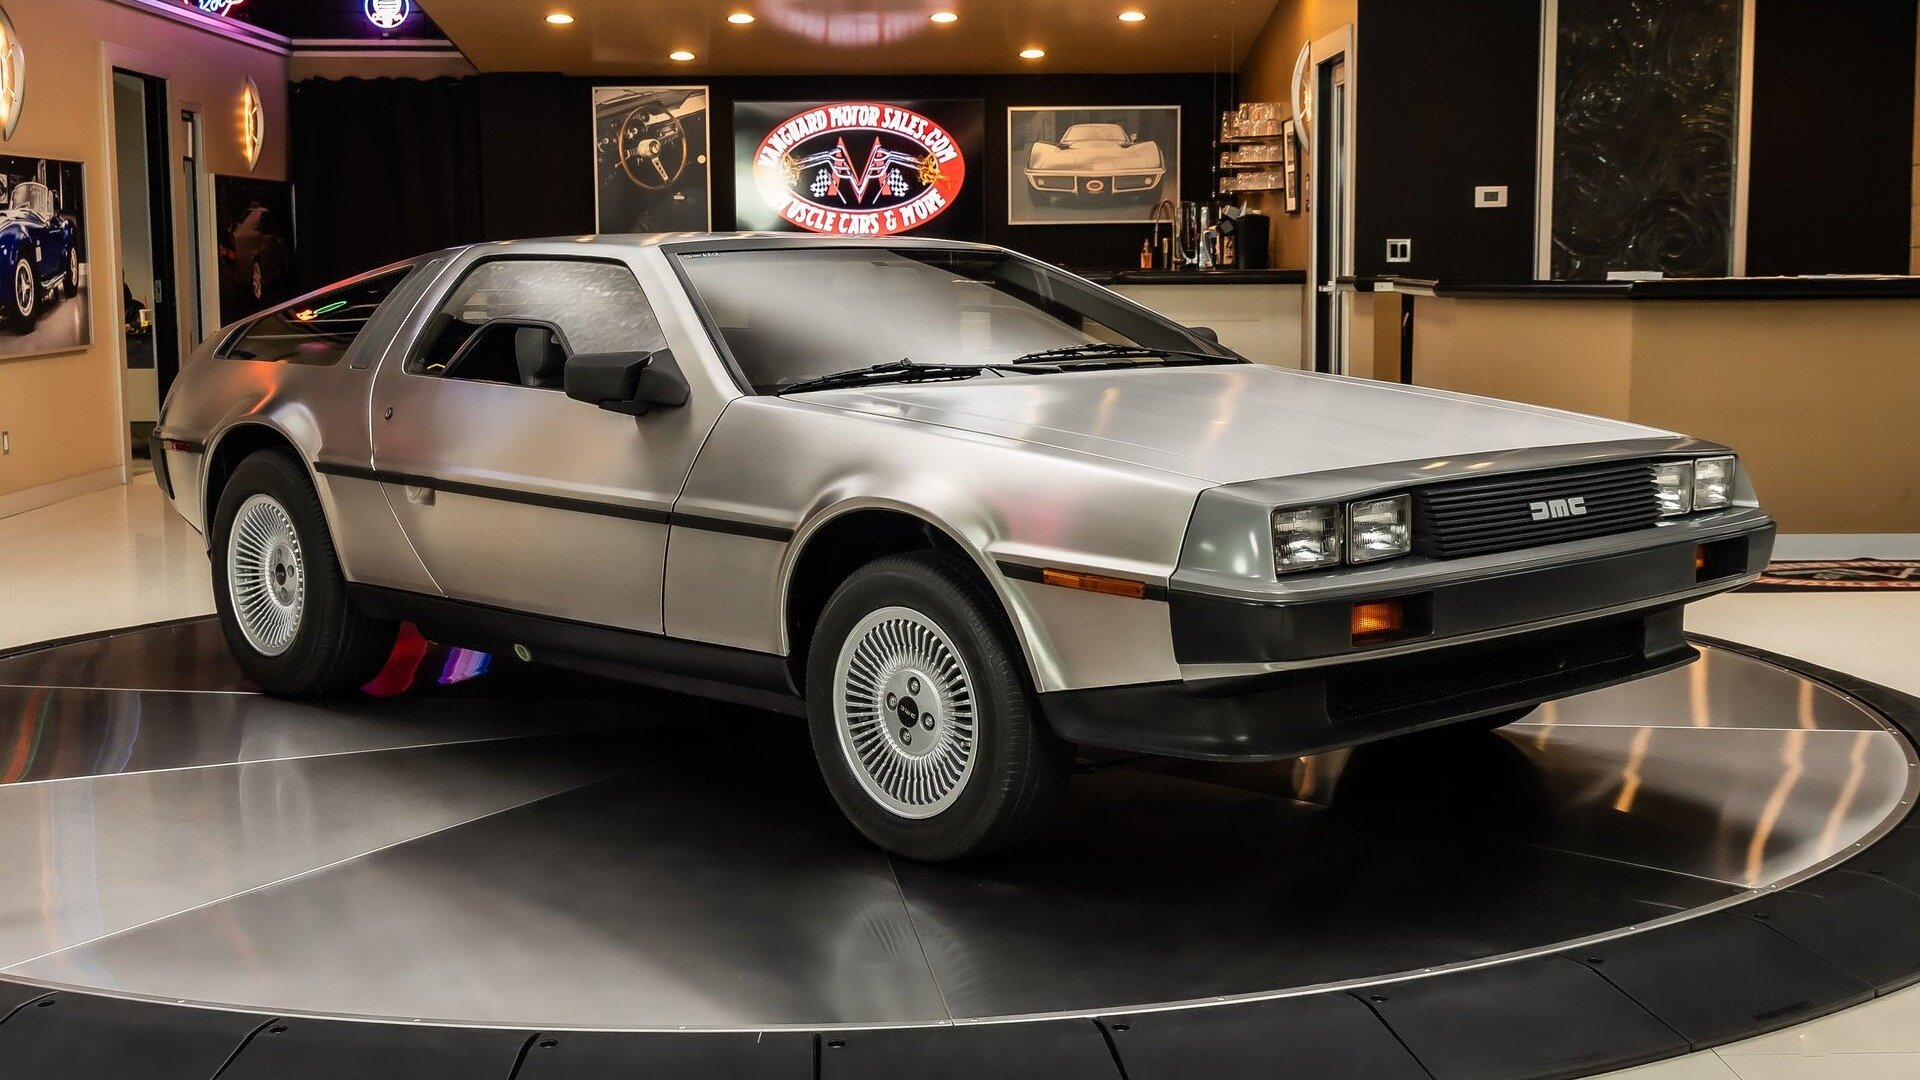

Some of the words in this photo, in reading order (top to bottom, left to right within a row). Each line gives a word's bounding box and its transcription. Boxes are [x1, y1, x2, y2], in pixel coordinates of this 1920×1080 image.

[757, 109, 827, 169] VANGUARD
[828, 105, 881, 128] MOTOR
[882, 107, 958, 164] SALES.COM
[773, 189, 836, 232] USCLE
[838, 212, 879, 235] CARS
[885, 209, 897, 231] &
[899, 187, 946, 227] MORE
[1529, 497, 1587, 520] DMC
